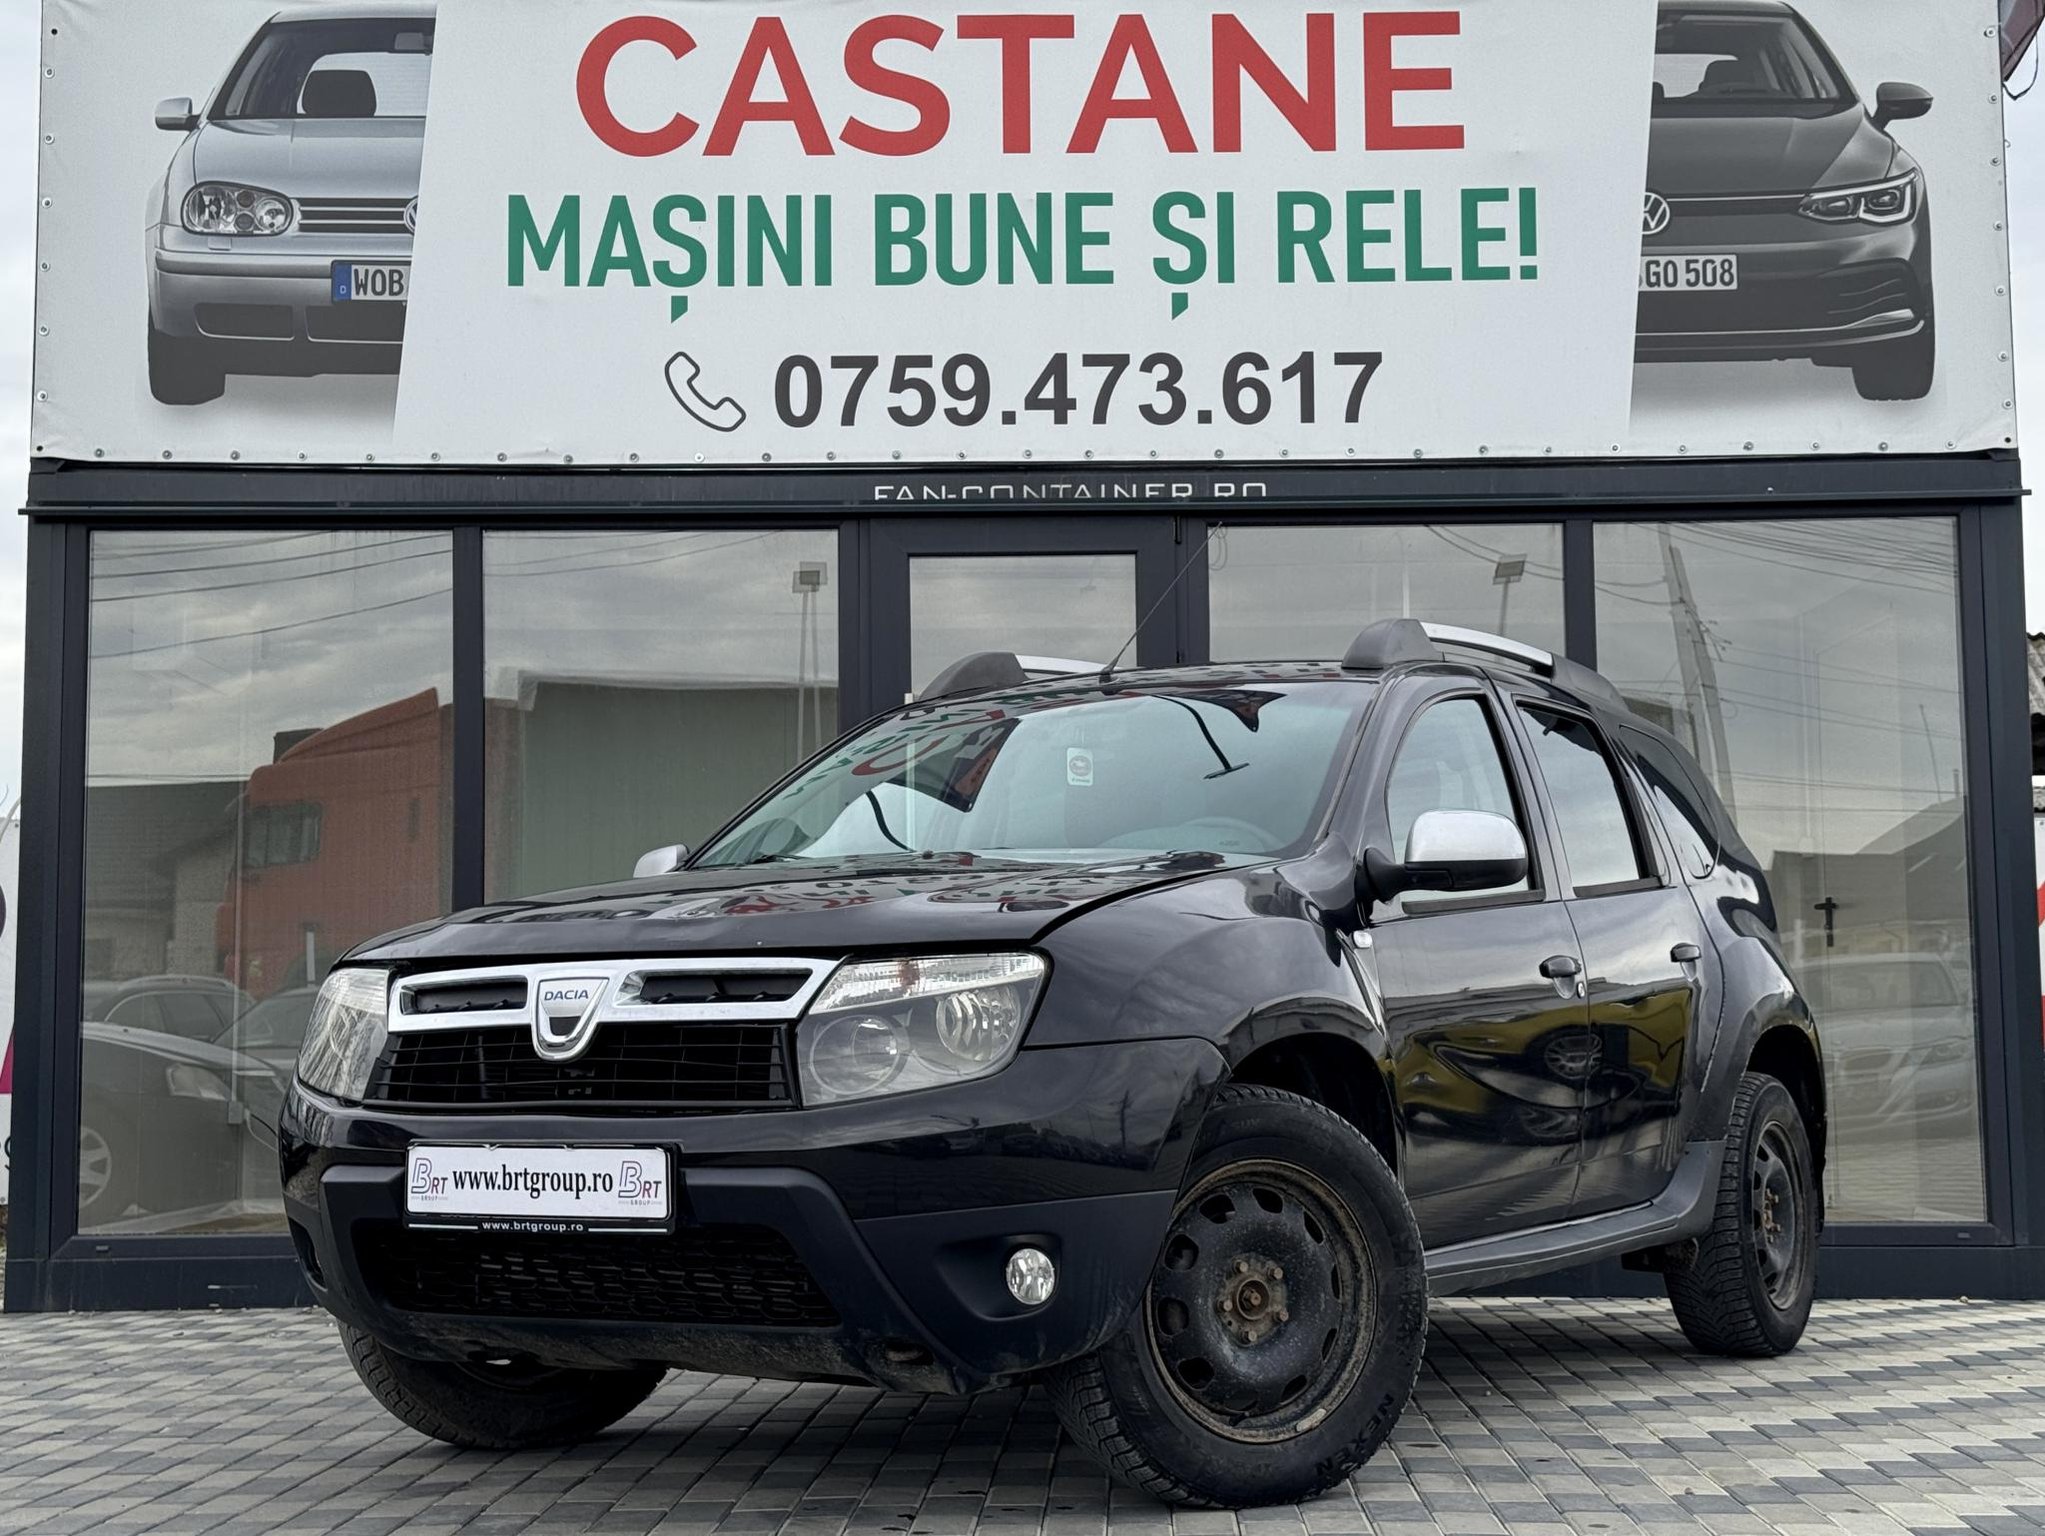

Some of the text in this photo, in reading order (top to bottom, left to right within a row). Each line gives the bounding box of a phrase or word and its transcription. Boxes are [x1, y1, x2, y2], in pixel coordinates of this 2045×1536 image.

[577, 12, 1463, 156] CASTANE
[508, 188, 1538, 320] MAȘINI BUNE ȘI RELE!
[354, 269, 404, 296] WOB
[1685, 258, 1734, 287] 508
[775, 352, 1382, 427] 0759.473.617
[544, 990, 589, 1001] DACIA
[453, 1164, 613, 1200] www.brtgroup.ro
[482, 1221, 584, 1232] www.brtgroup.ro
